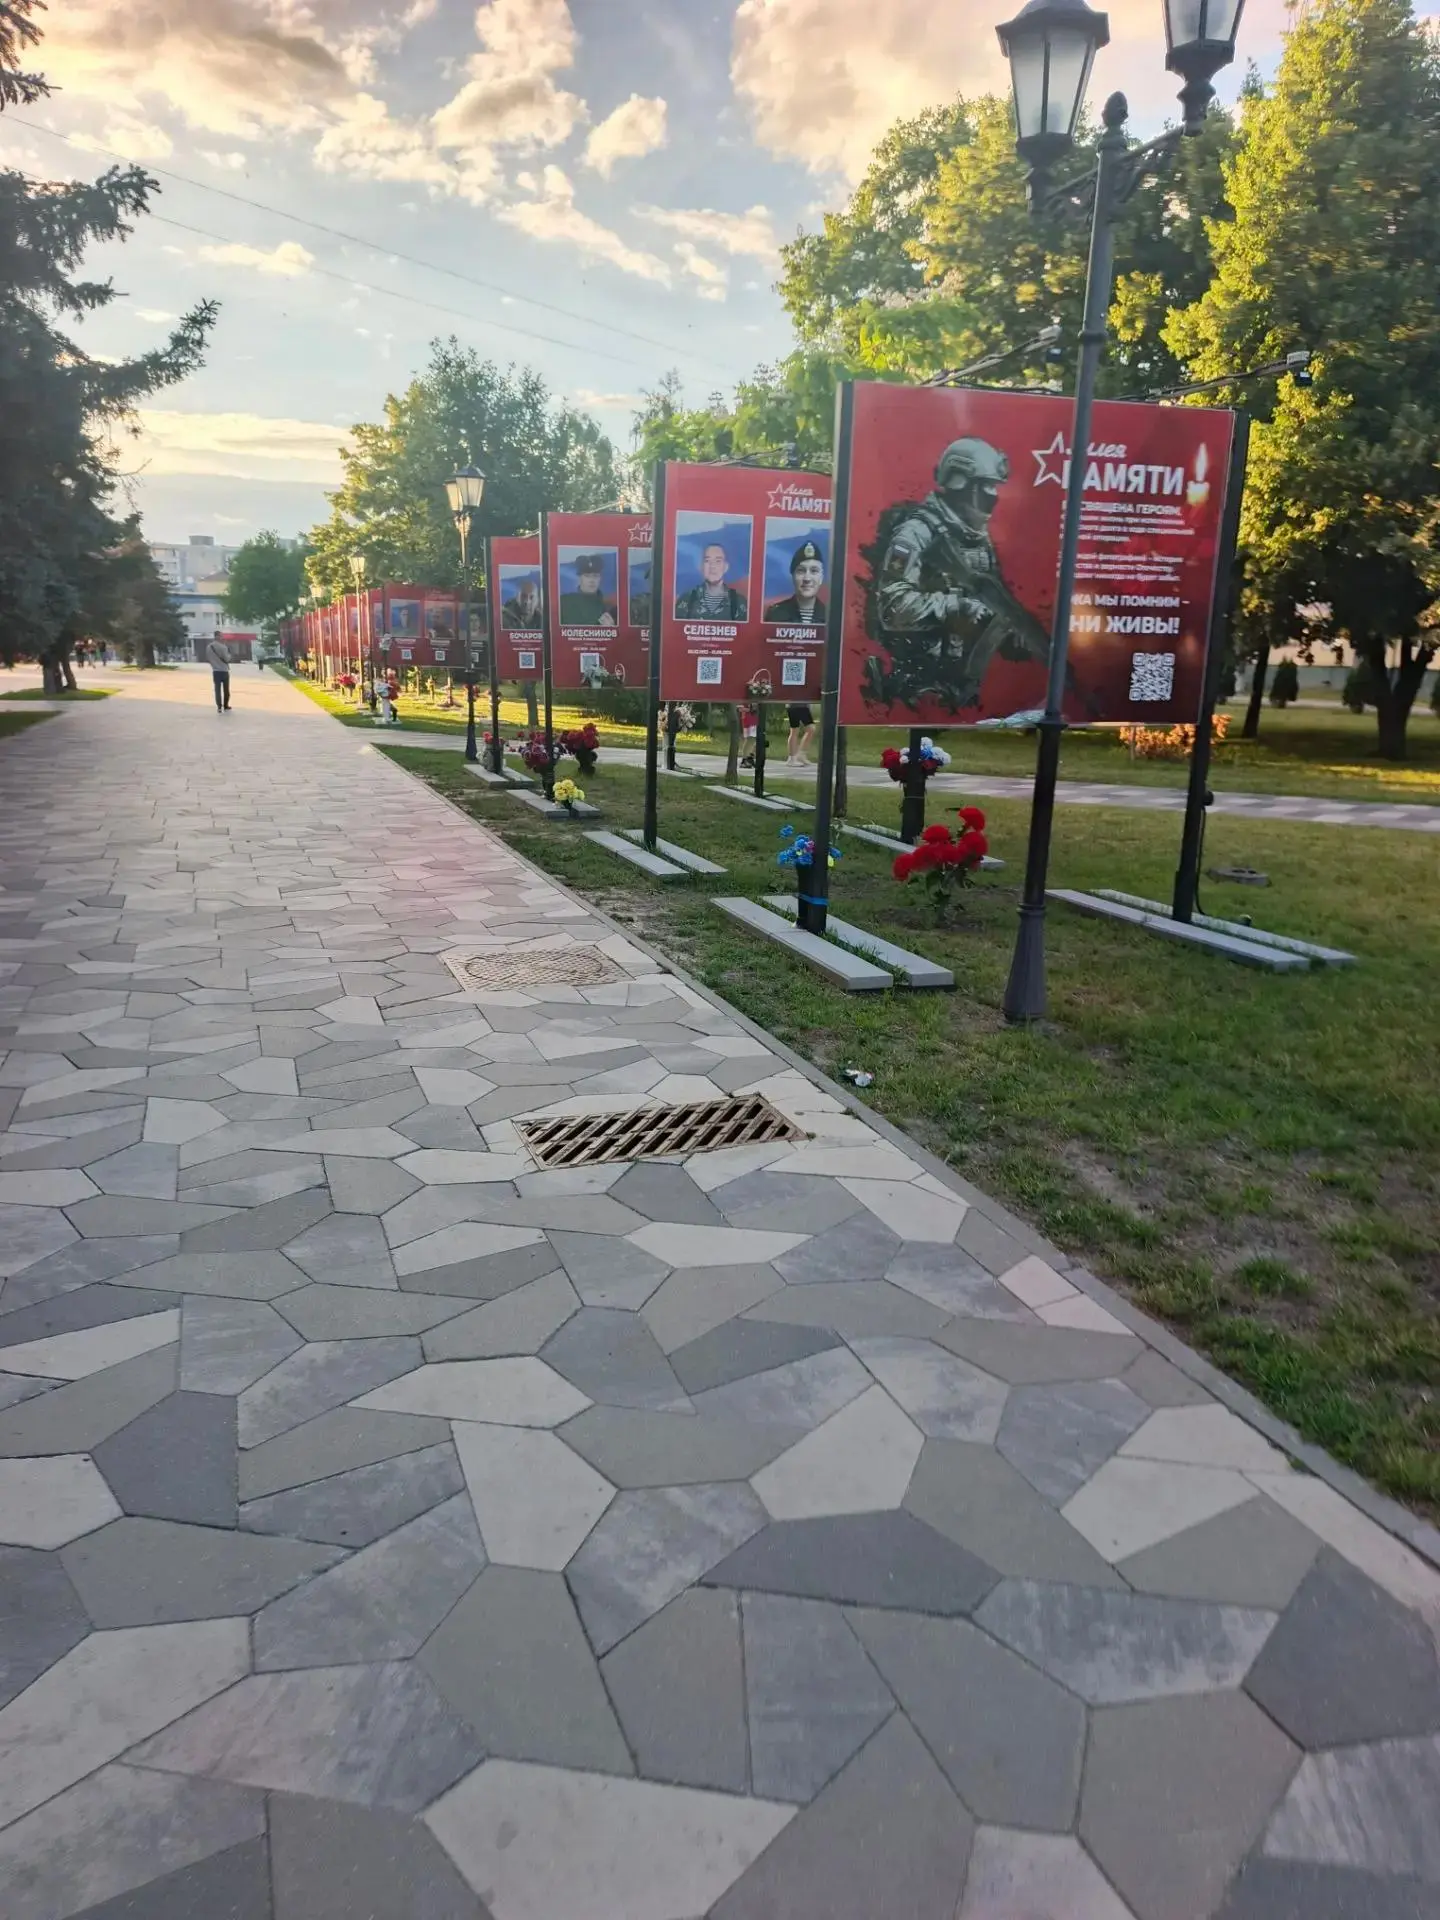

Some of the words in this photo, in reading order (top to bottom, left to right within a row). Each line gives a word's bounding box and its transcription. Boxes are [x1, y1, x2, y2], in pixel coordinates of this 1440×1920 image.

[781, 496, 832, 513] ПАМЯТ
[1095, 595, 1118, 606] МЫ
[684, 625, 737, 635] СЕЛЕЗНЕВ
[1069, 615, 1101, 632] НИ
[1104, 616, 1180, 634] ЖИВЫ!
[561, 629, 617, 638] КОЛЕСНИКОВ
[776, 628, 816, 639] КУРДИН
